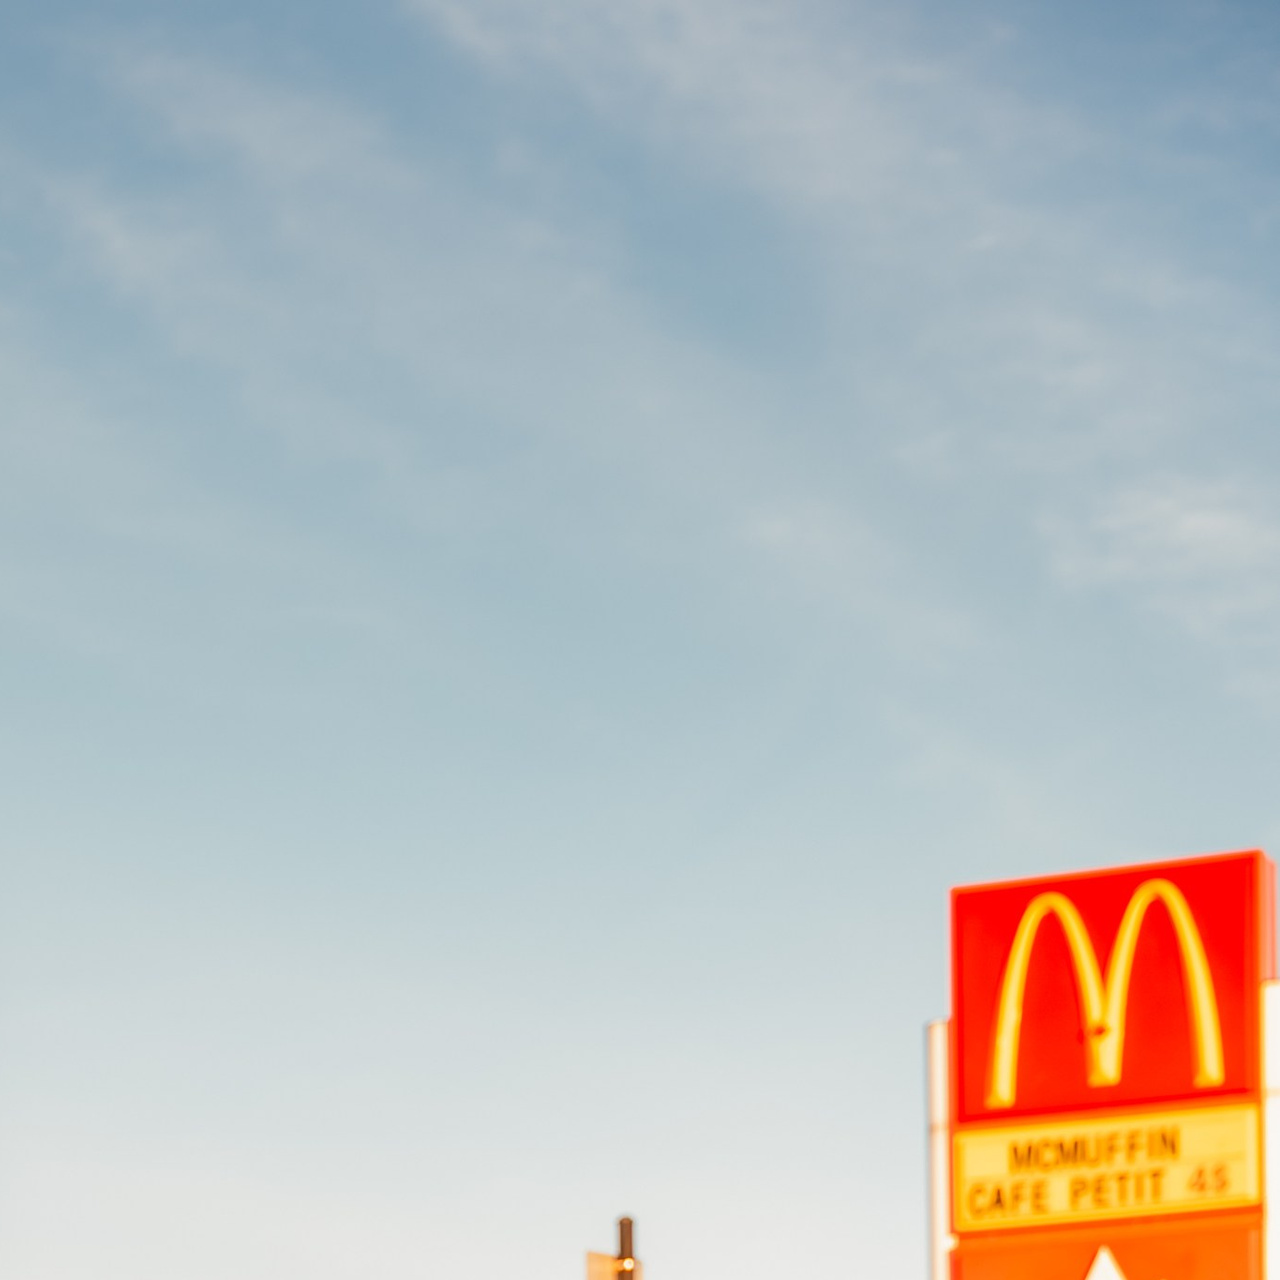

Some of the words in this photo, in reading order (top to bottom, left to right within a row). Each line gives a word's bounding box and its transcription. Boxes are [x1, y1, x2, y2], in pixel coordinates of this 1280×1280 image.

[1010, 1127, 1179, 1172] MCMUFFIN
[969, 1179, 1050, 1218] CAFE
[1070, 1168, 1164, 1210] PETIT
